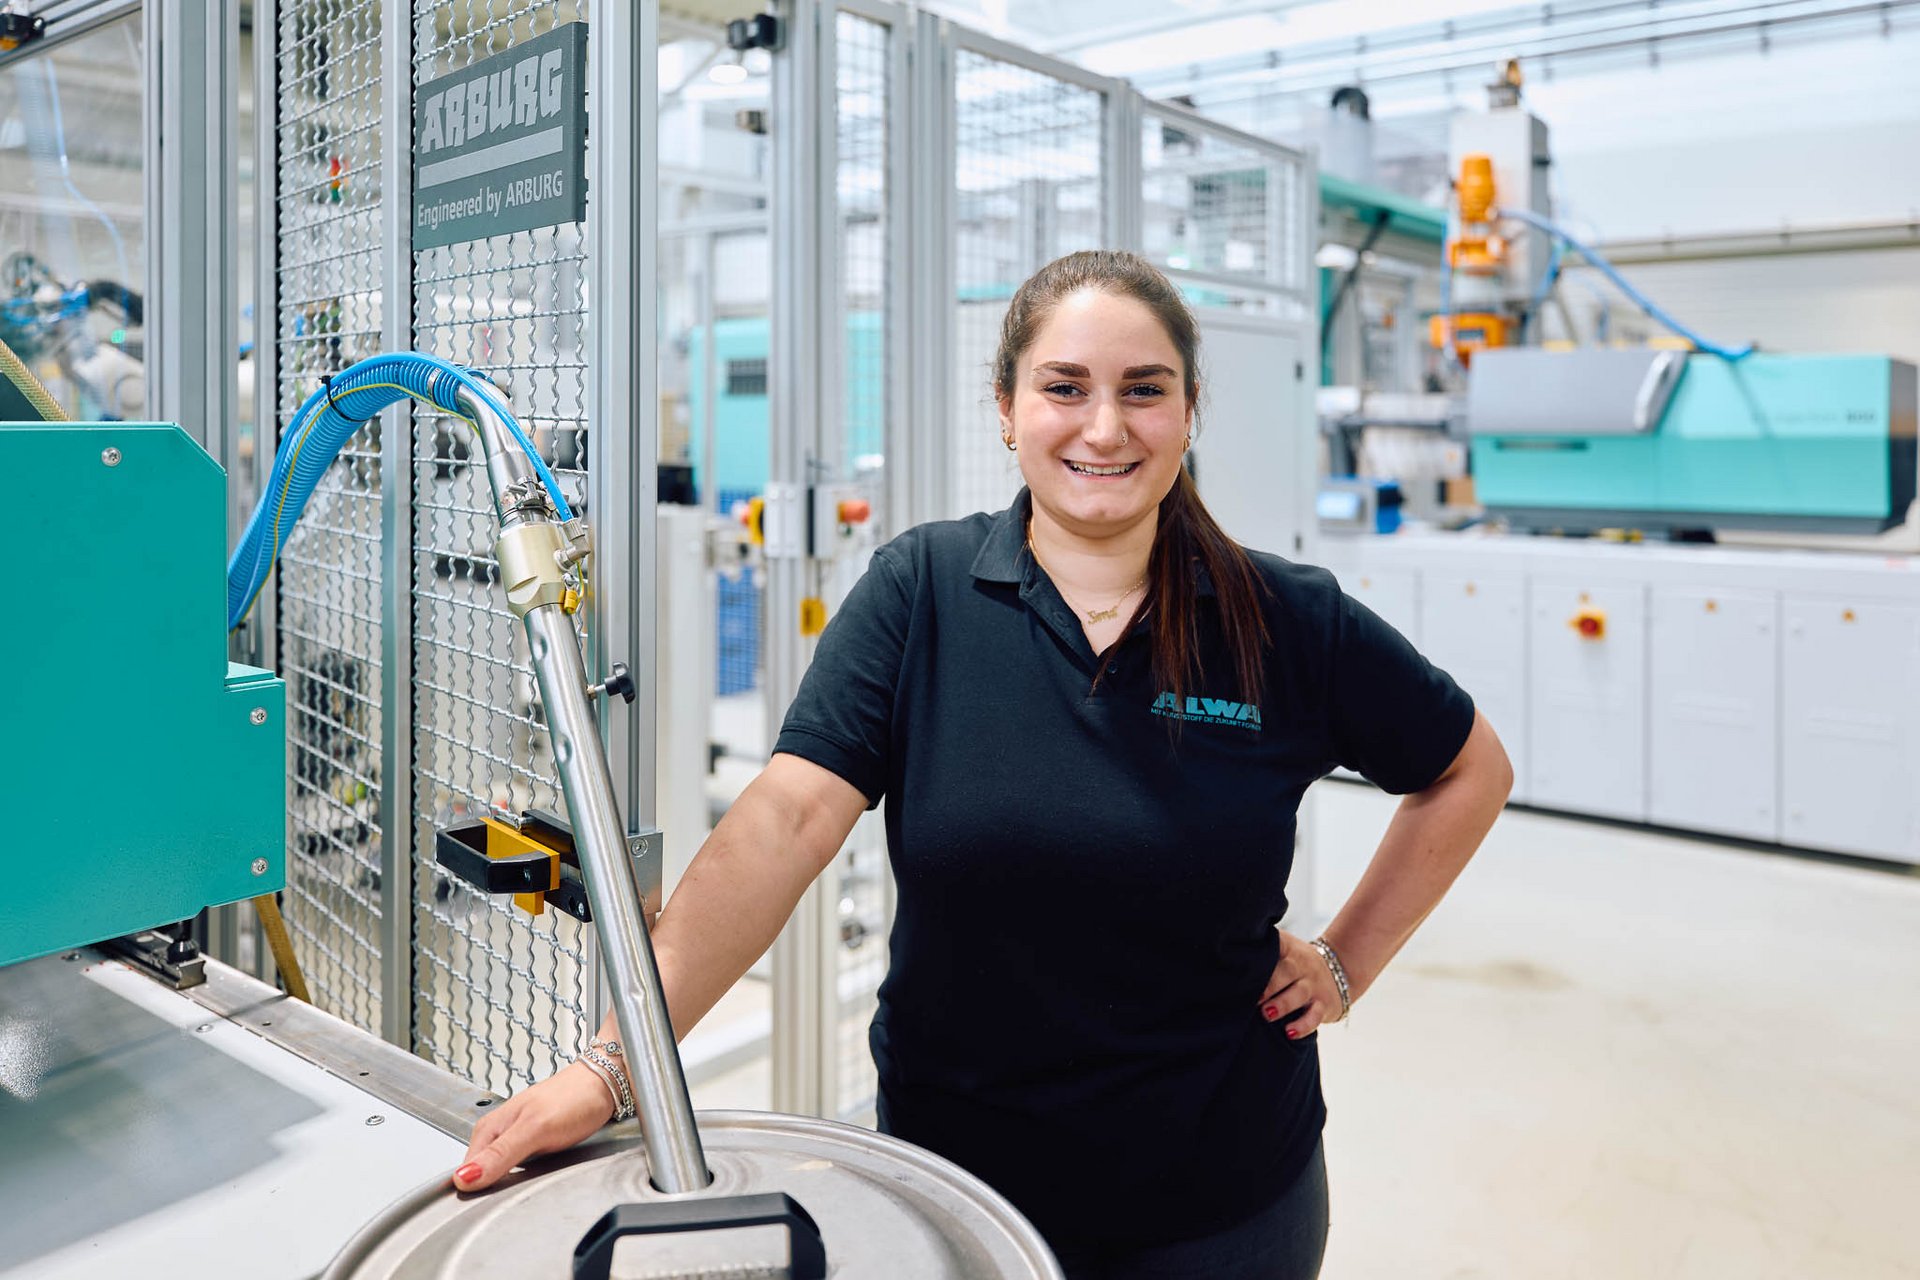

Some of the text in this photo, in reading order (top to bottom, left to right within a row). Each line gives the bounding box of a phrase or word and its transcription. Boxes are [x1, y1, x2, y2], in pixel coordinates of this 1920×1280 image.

[420, 48, 563, 154] ARBURG
[418, 170, 563, 230] Engineered by ARBURG
[1152, 691, 1261, 723] ALWA
